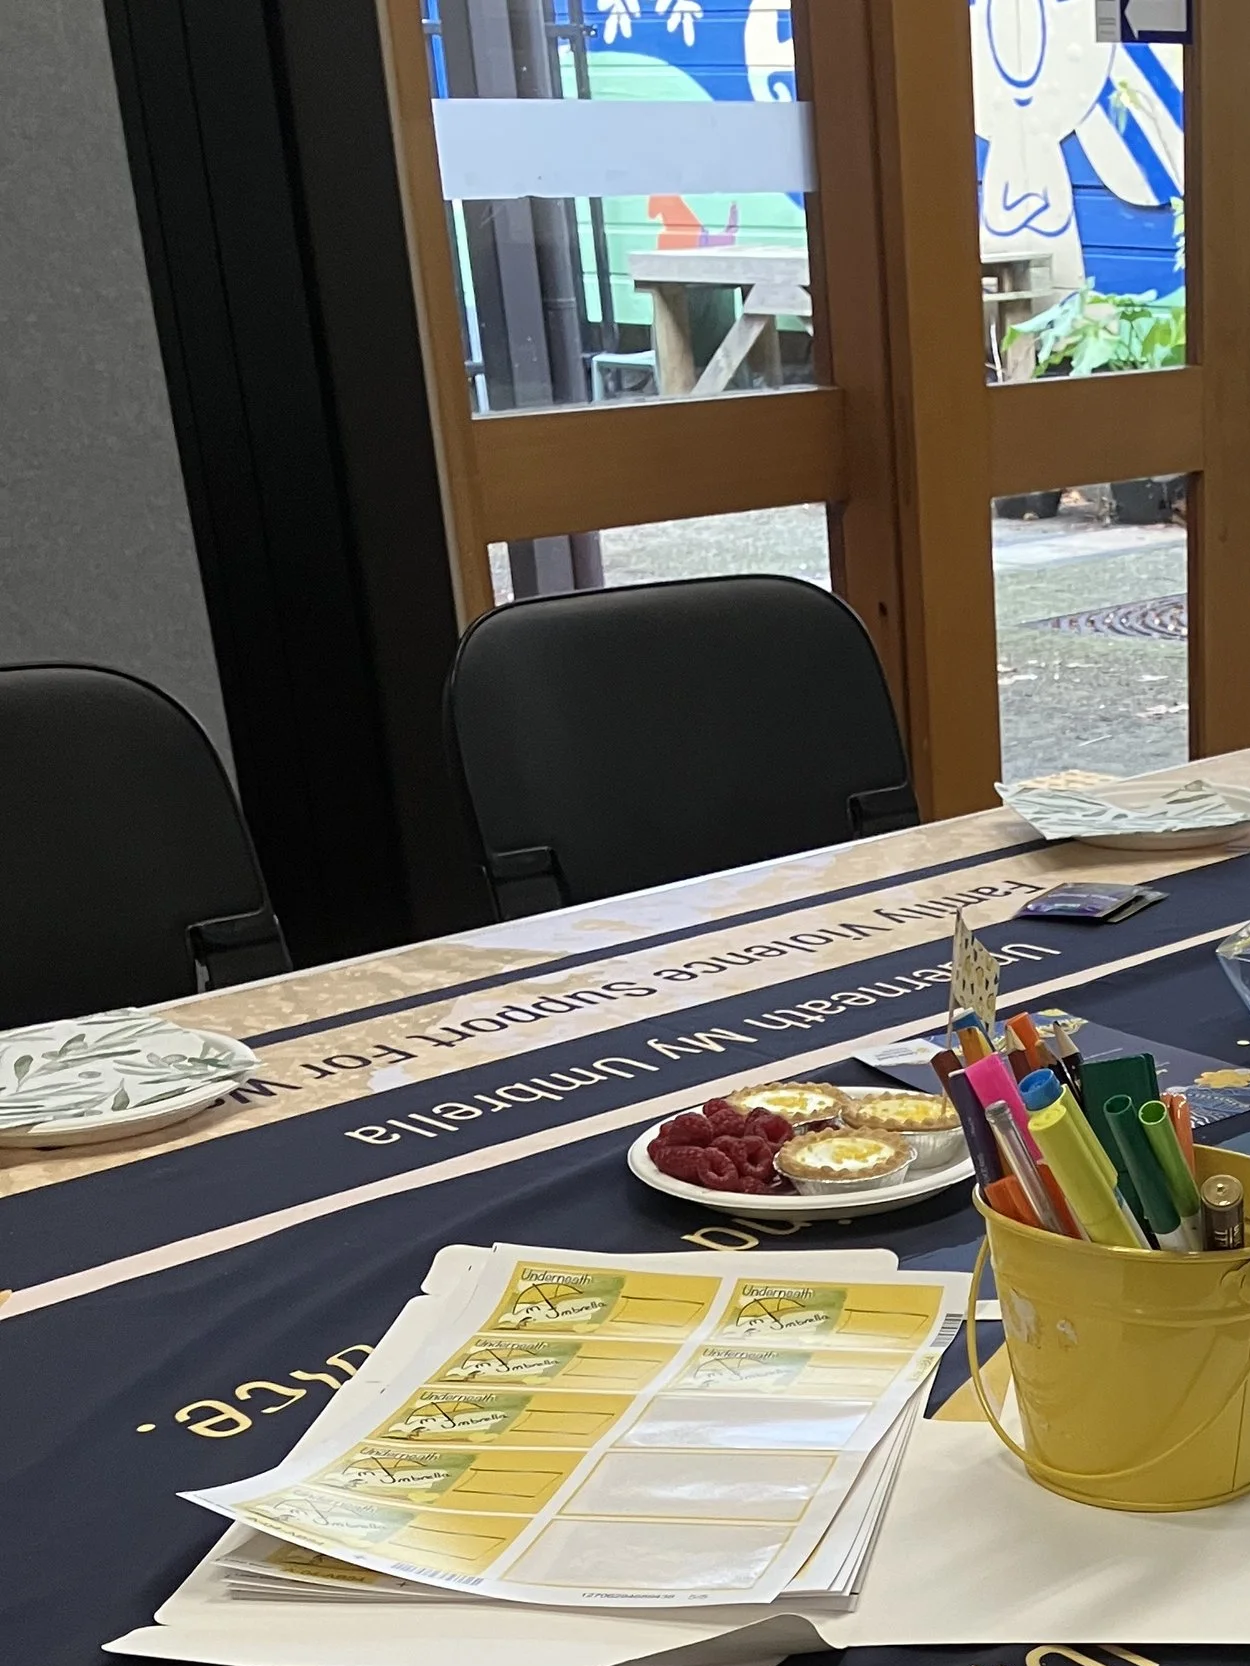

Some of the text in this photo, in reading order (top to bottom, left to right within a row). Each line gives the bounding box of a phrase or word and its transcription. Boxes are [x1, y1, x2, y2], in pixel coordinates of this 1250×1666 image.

[302, 880, 1045, 1080] Family Violence Support For
[344, 942, 1062, 1146] Unerneath My Umbrella
[521, 1268, 592, 1286] Underneath
[742, 1284, 814, 1299] Underneath
